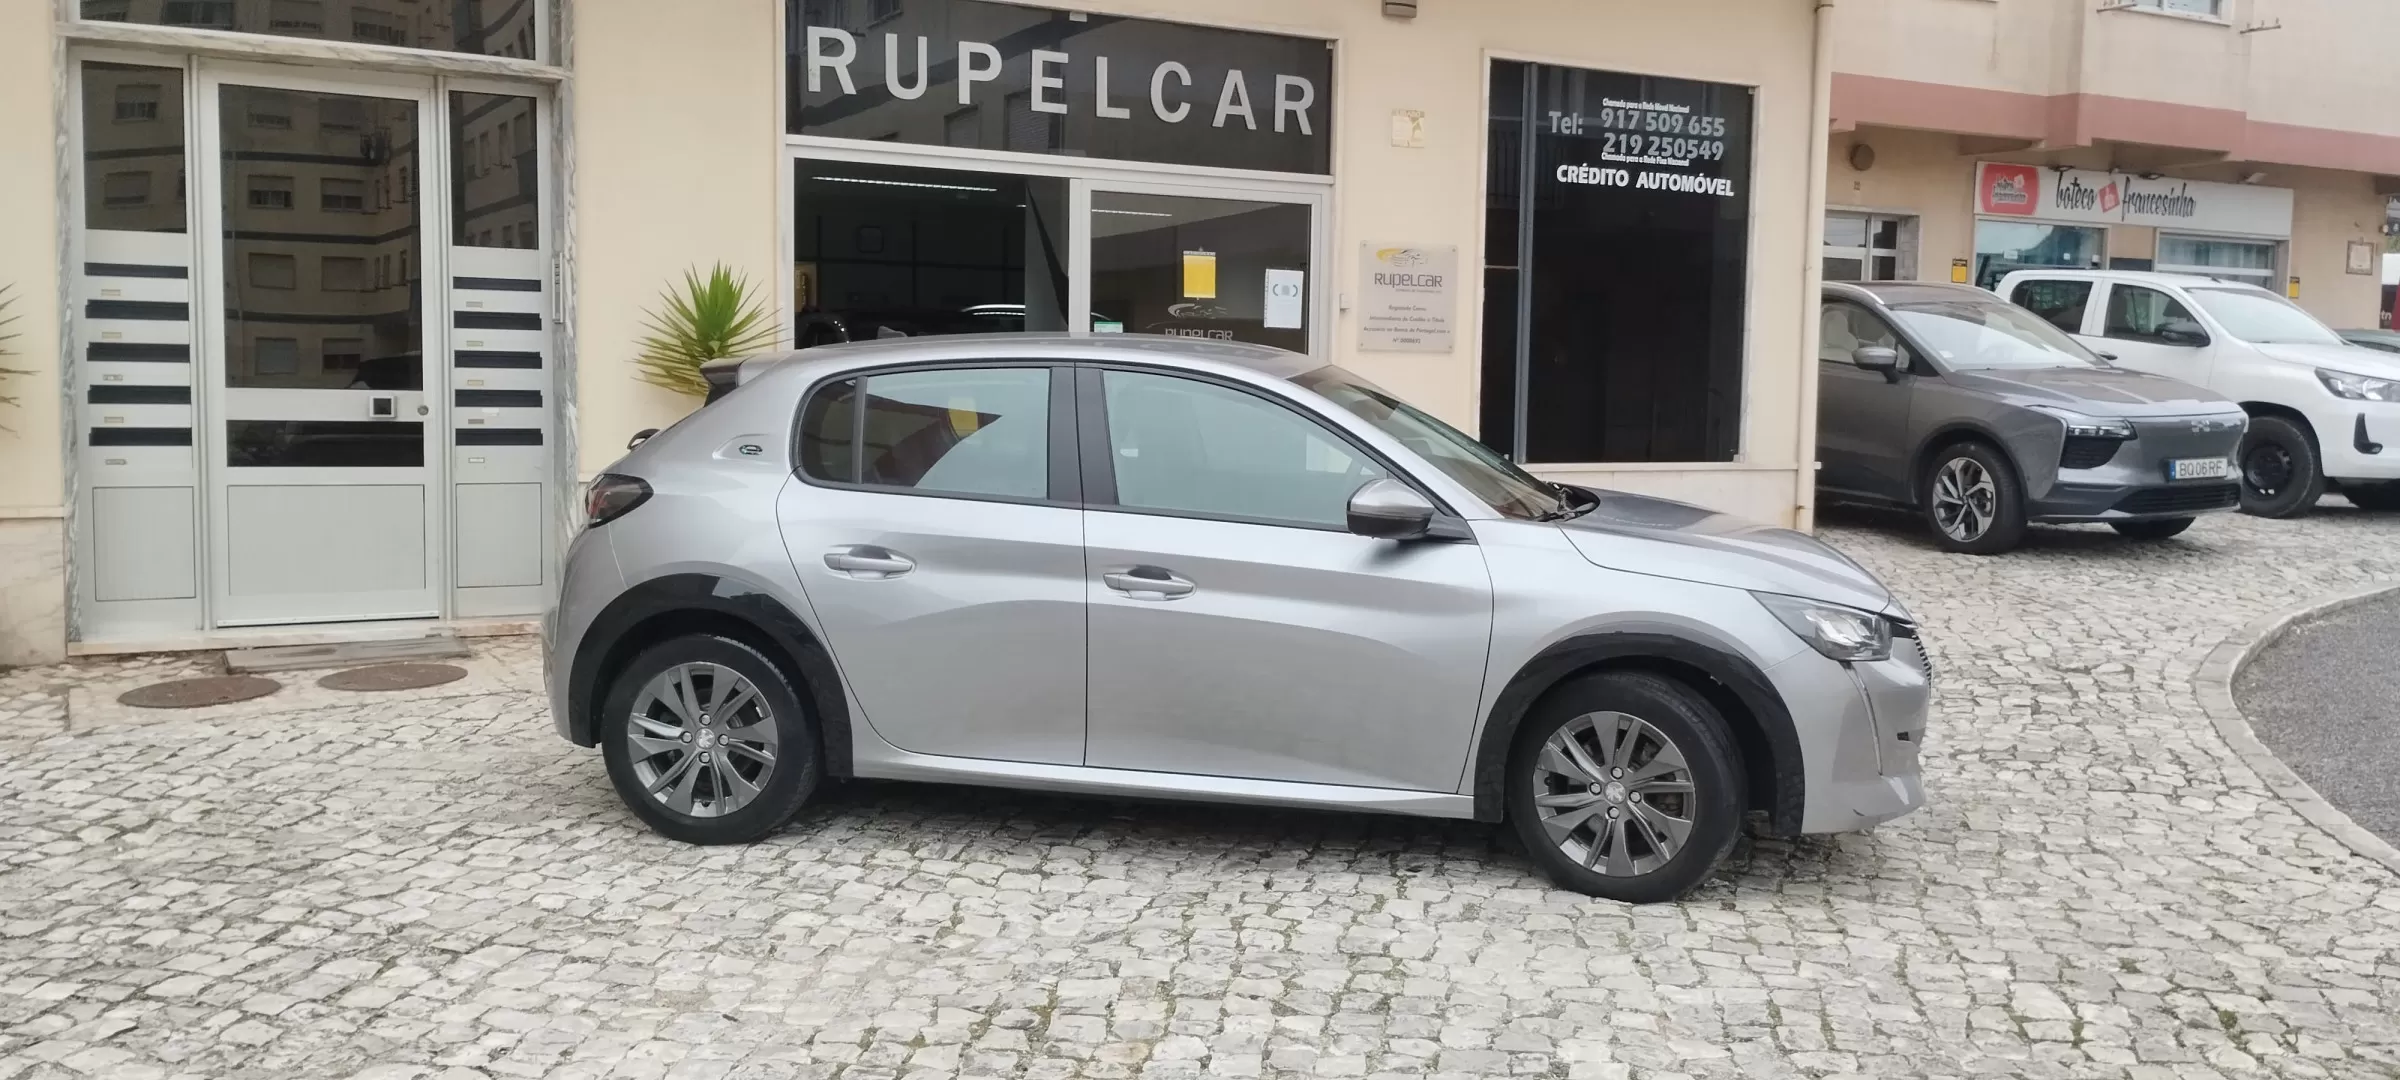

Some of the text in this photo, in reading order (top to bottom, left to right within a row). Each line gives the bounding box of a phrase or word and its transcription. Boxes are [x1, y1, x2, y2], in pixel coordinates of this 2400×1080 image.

[807, 26, 1315, 135] RUPELCAR
[1549, 108, 1725, 136] Tel: 917 509 655
[1602, 132, 1724, 160] 219 250549
[1557, 163, 1734, 196] CRÉDITO AUTOMÓVEL
